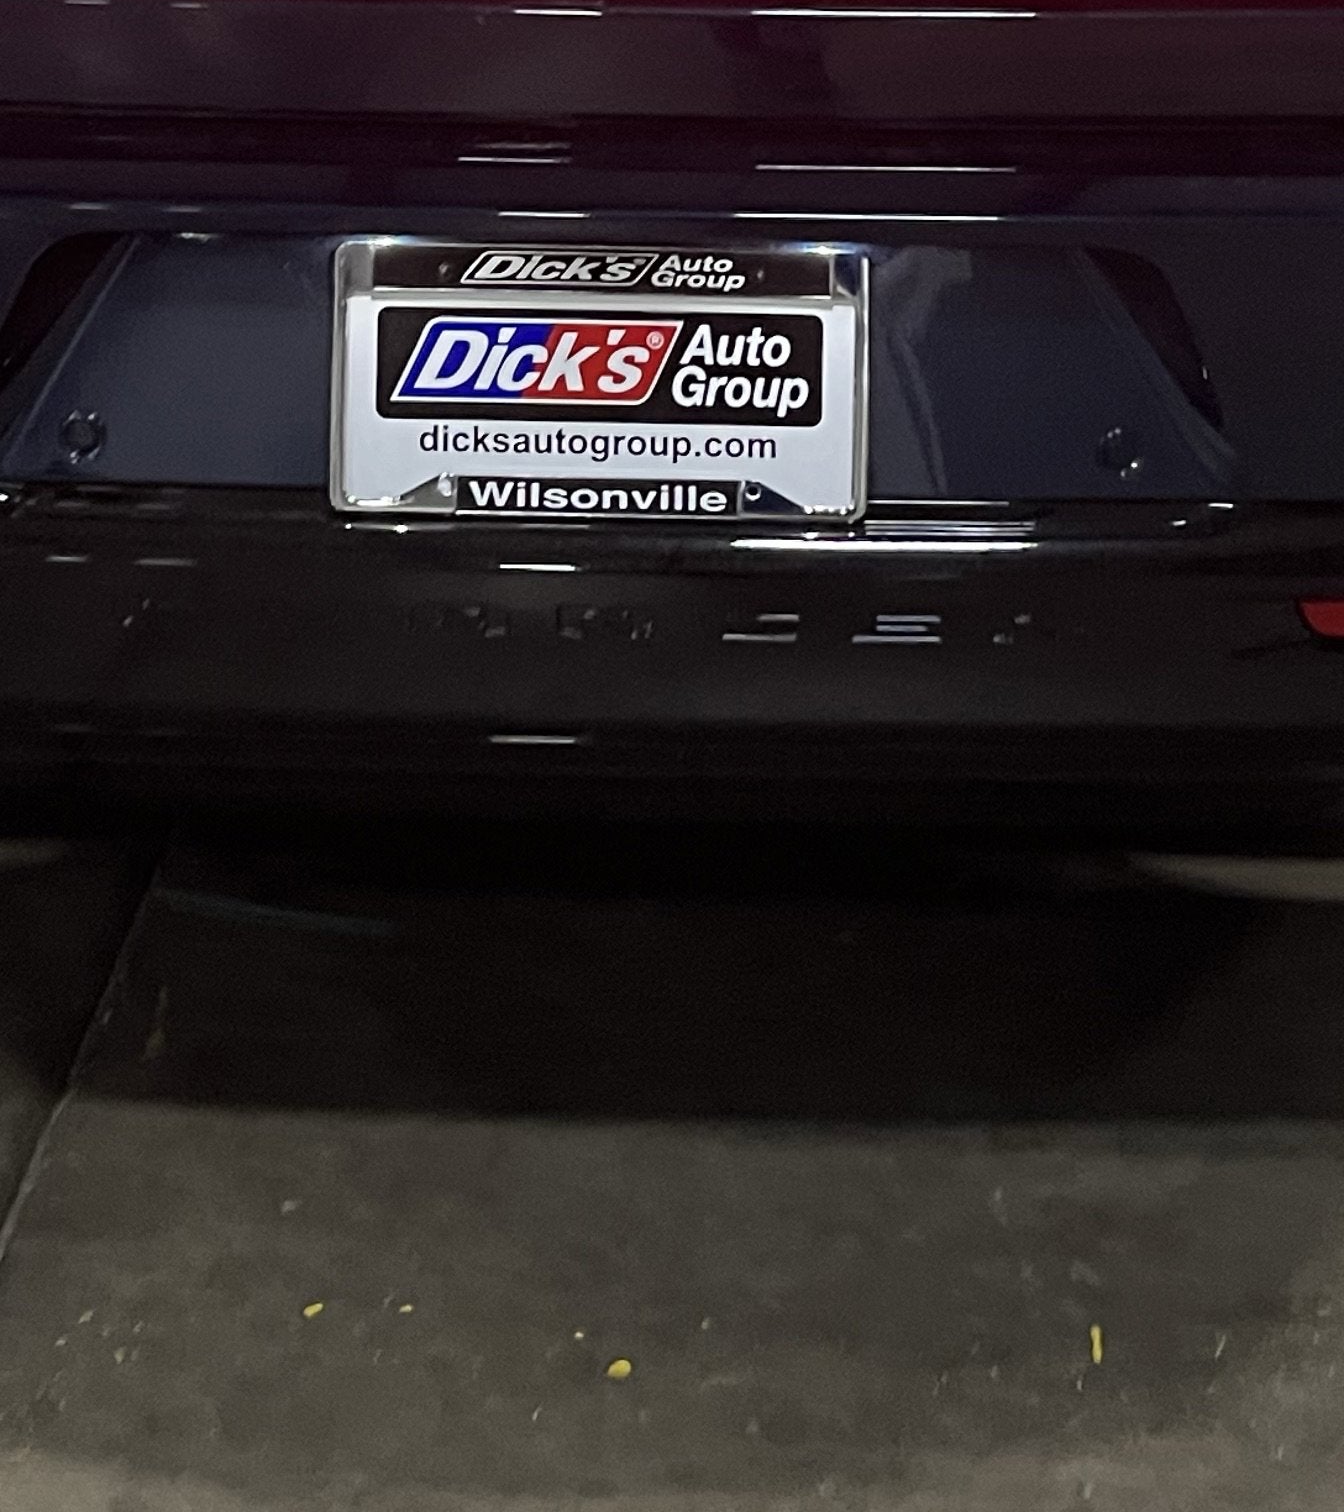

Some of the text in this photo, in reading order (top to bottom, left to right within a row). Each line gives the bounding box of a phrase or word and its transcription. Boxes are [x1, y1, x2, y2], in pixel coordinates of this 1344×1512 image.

[661, 254, 733, 272] Auto
[651, 271, 745, 291] Group
[680, 324, 791, 367] Auto
[671, 367, 809, 417] Group
[419, 425, 777, 463] dicksautogroup.com
[469, 481, 728, 513] Wilsonville
